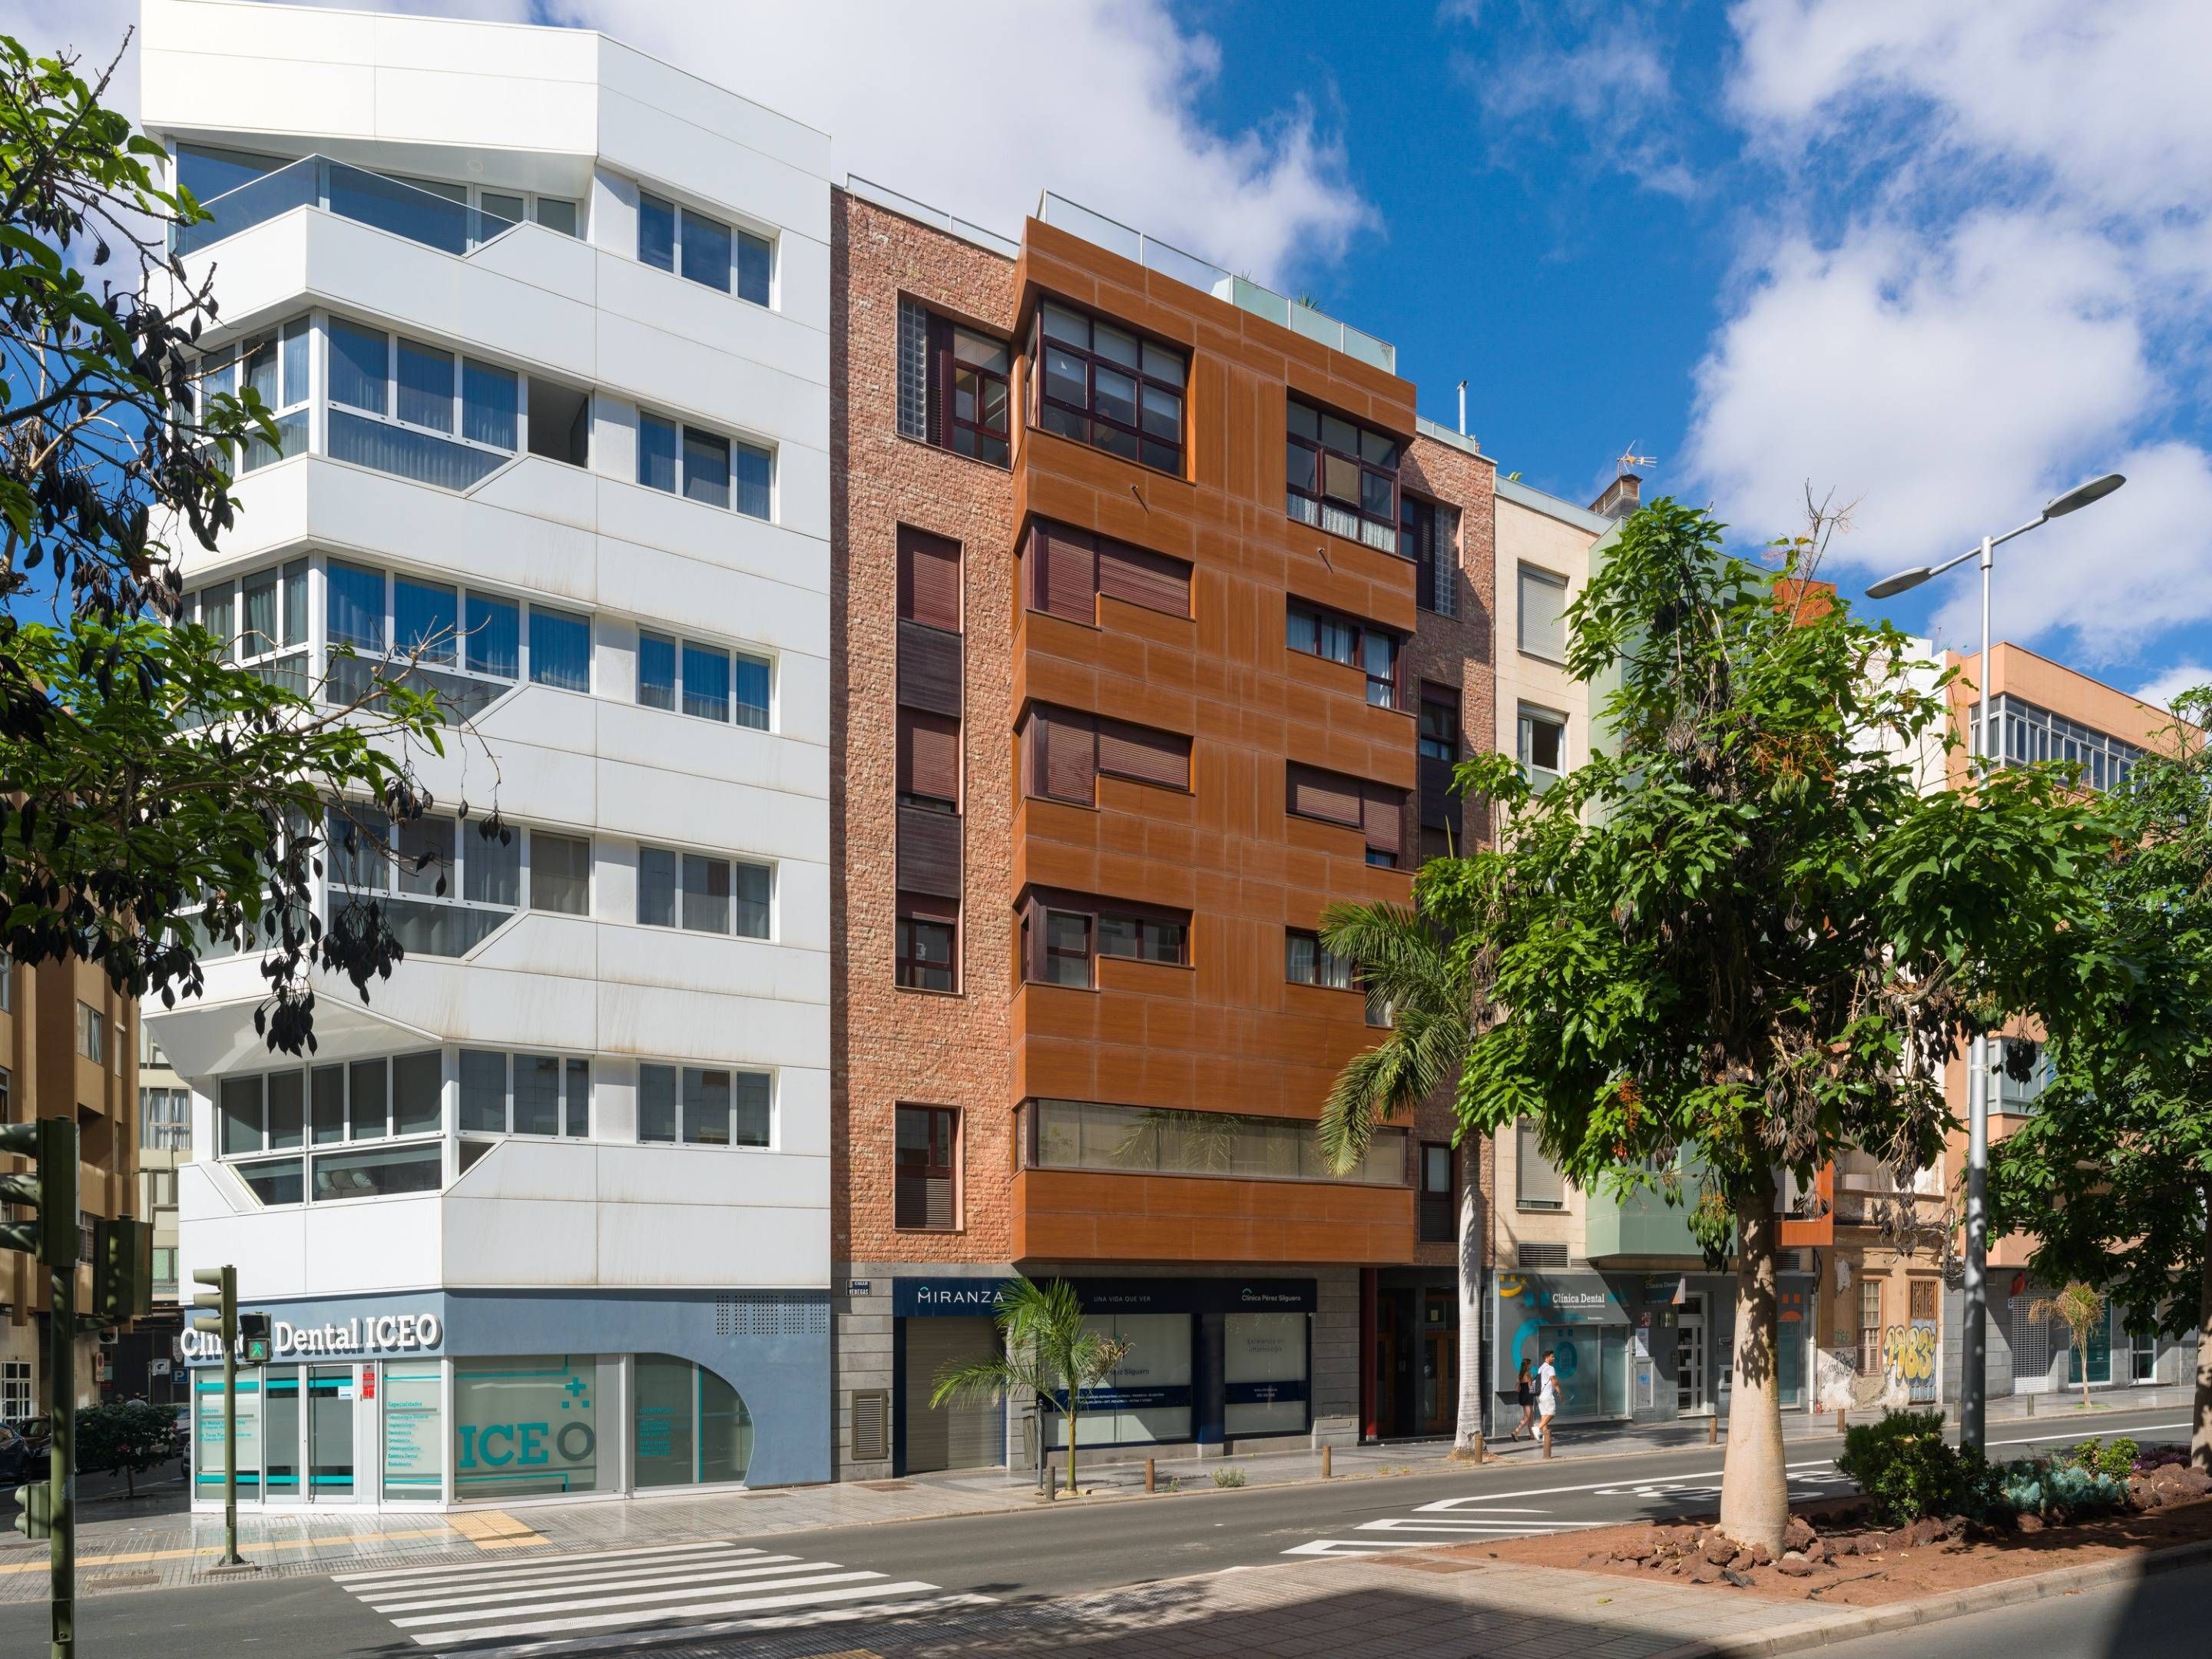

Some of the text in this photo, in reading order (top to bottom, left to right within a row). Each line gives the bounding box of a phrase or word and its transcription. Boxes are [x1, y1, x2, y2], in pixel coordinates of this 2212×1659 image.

[917, 1290, 1004, 1303] MIRANZA
[1552, 1293, 1604, 1303] Clínica Dental
[274, 1317, 359, 1352] Dental
[366, 1313, 438, 1348] ICEO
[174, 1370, 184, 1382] P
[458, 1421, 595, 1469] ICEO
